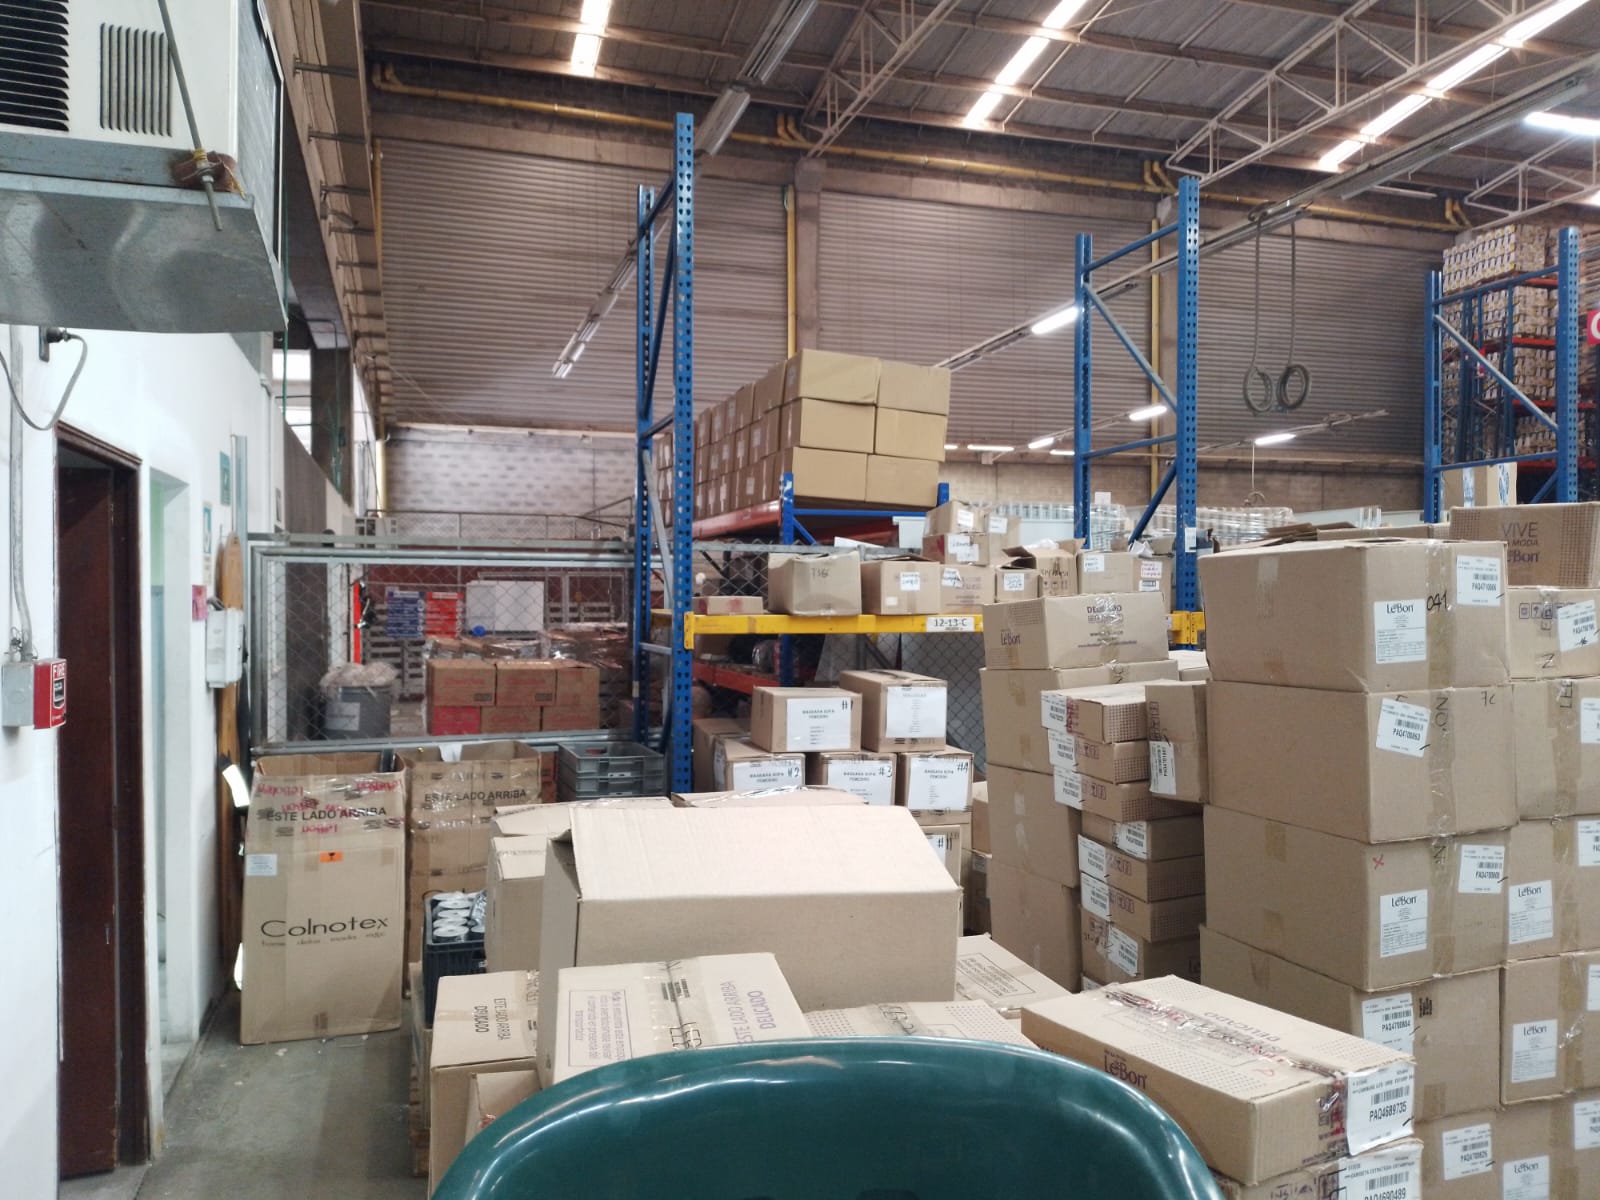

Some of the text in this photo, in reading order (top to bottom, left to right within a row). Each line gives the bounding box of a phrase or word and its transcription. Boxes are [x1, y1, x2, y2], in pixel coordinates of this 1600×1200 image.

[1503, 522, 1538, 537] VIVE
[934, 618, 967, 627] 12-13-C
[53, 662, 66, 678] FIRE
[425, 789, 527, 802] ESTE LADO ARRIBA
[266, 809, 297, 822] ESTE
[302, 809, 337, 821] LADO
[260, 916, 389, 938] Colnotex
[747, 990, 776, 1030] DELICADO
